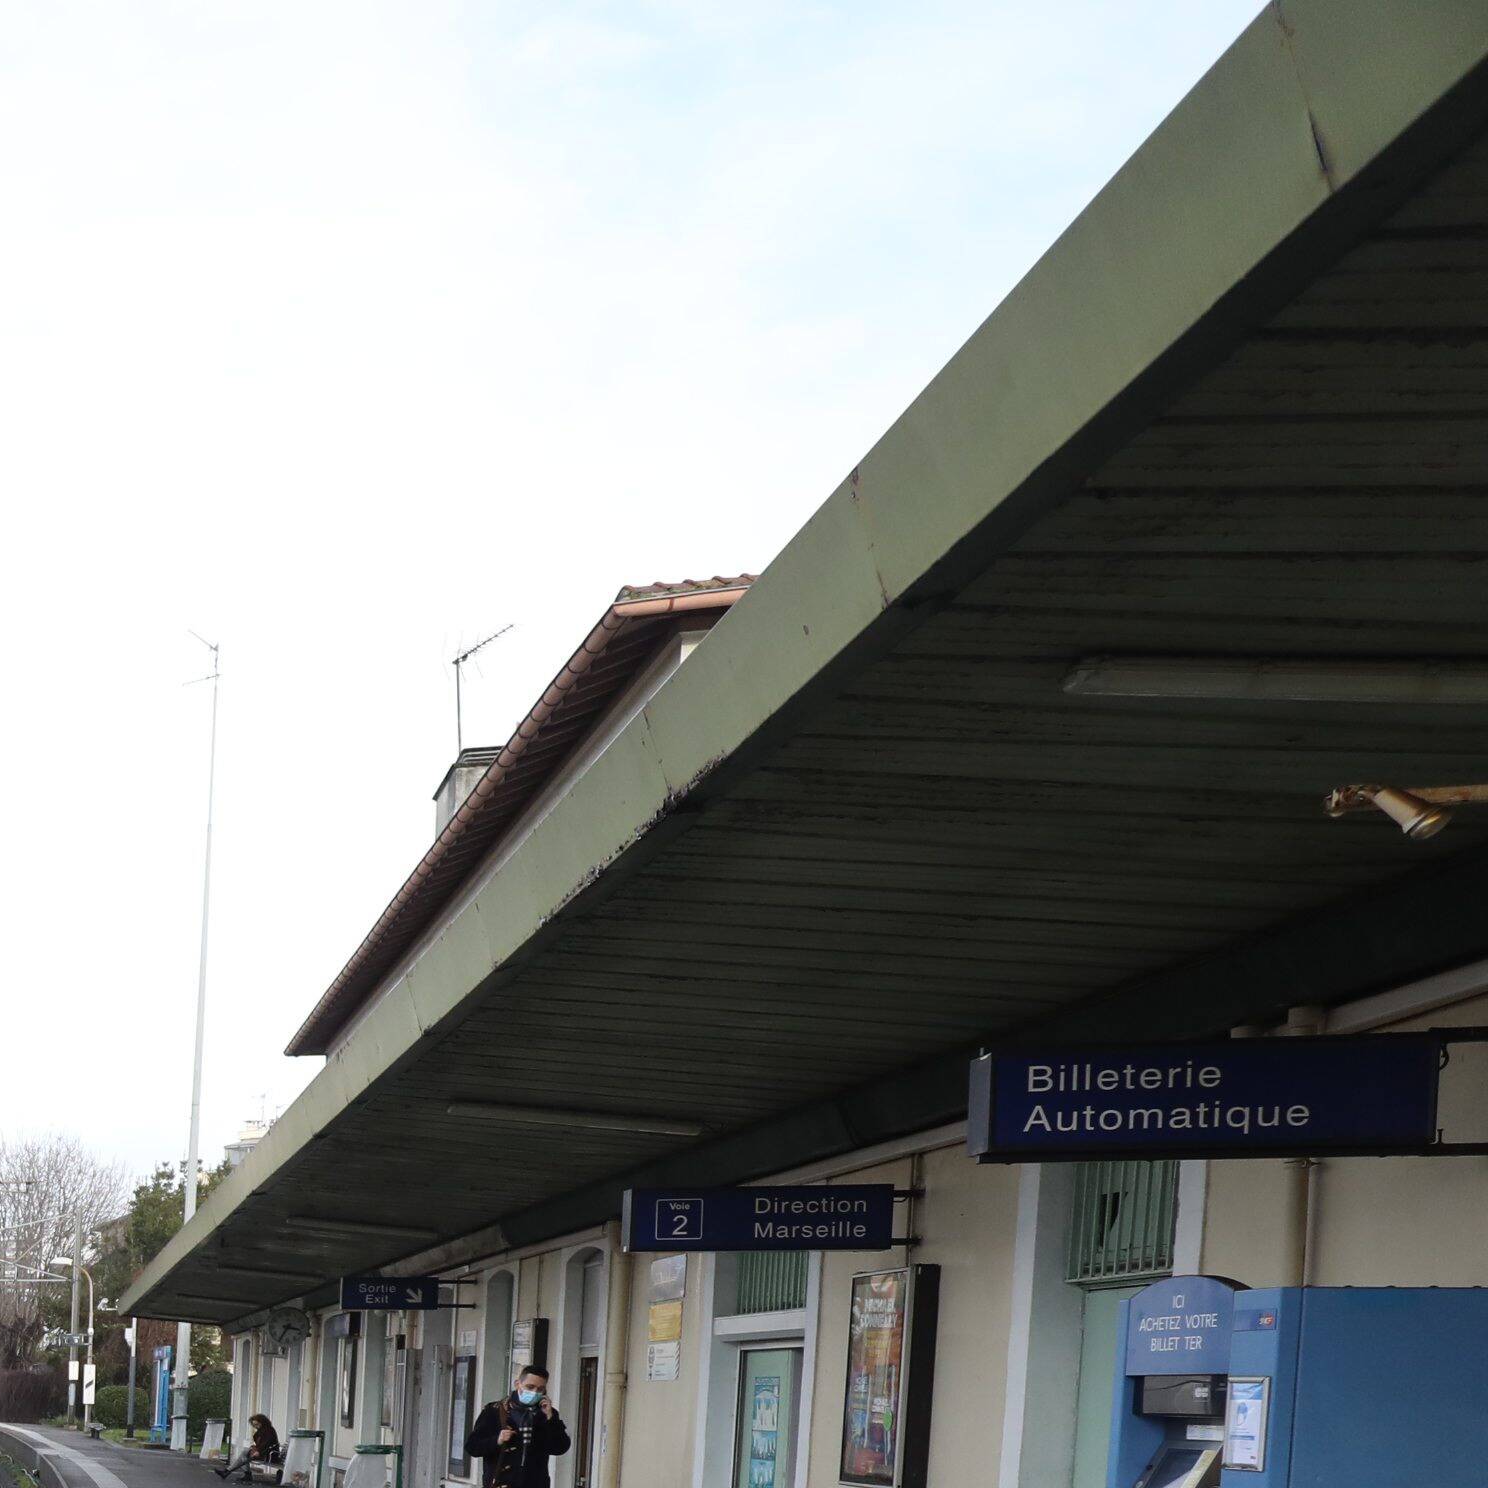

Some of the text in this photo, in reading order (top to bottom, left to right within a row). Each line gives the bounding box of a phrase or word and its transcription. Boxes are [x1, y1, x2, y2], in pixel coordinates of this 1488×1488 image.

[1027, 1060, 1222, 1093] Billeterie
[1023, 1100, 1311, 1135] Automatique
[670, 1201, 690, 1211] Voie
[754, 1197, 867, 1215] Direction
[672, 1214, 688, 1236] 2
[754, 1221, 867, 1239] Marseille
[359, 1283, 397, 1293] Sortie
[365, 1294, 389, 1304] Exit
[1172, 1294, 1185, 1309] ICI
[1139, 1313, 1219, 1332] ACHETEZ VOTRE
[1150, 1335, 1203, 1352] BILLET TER
